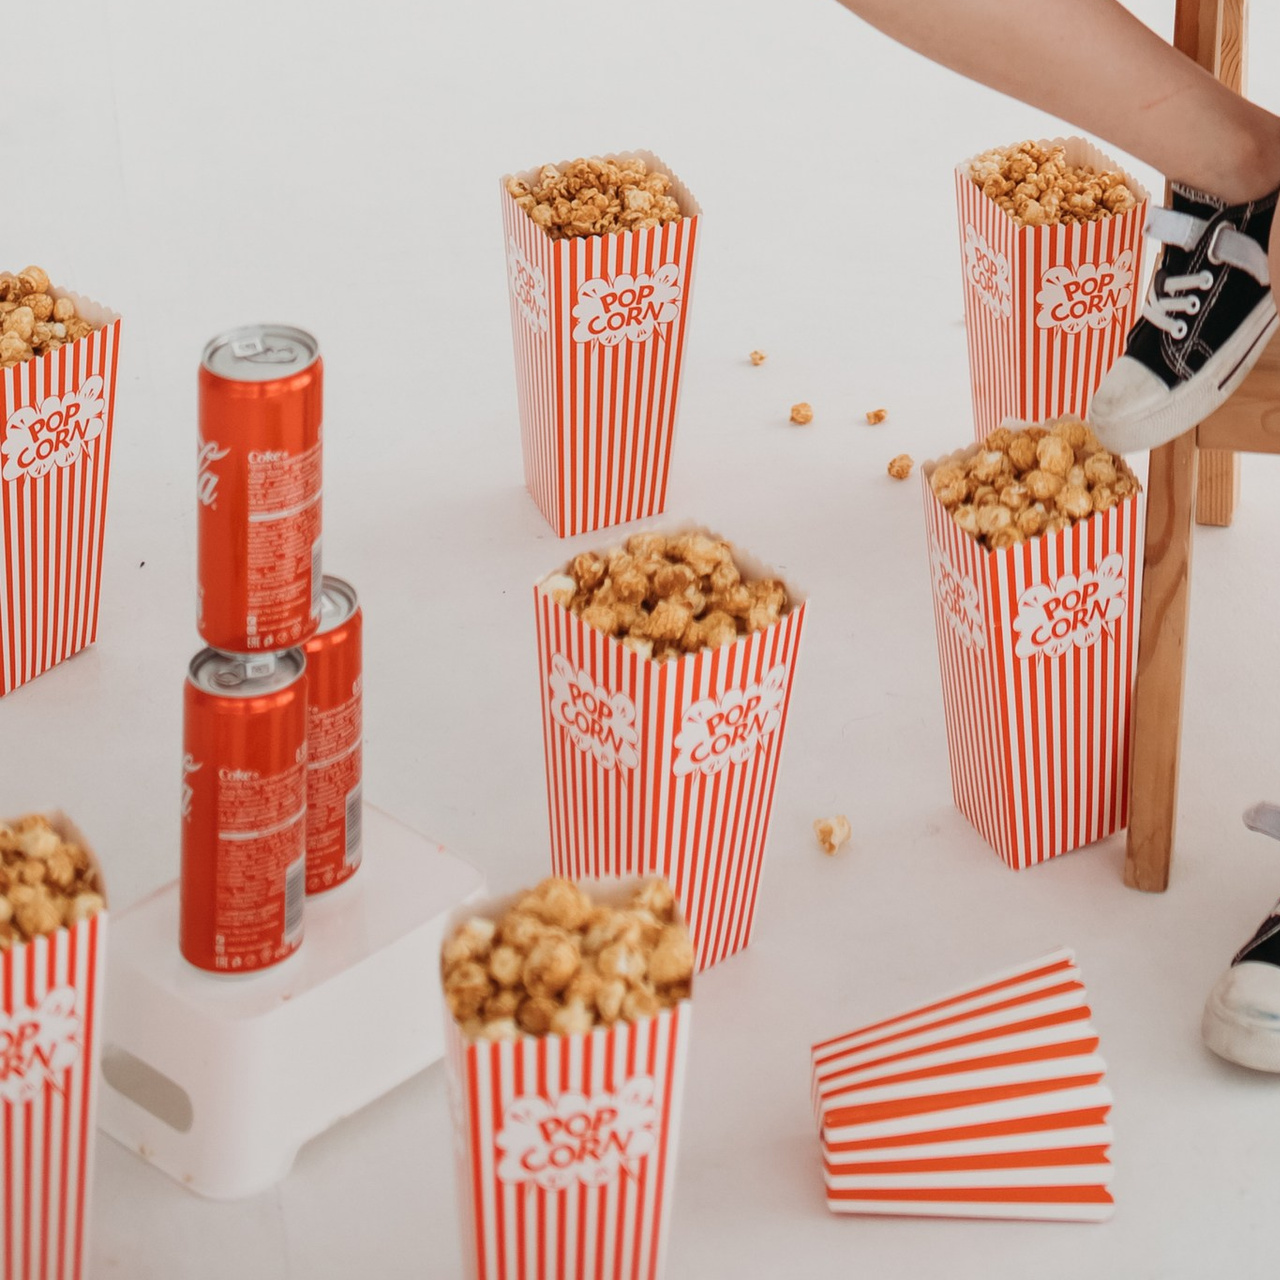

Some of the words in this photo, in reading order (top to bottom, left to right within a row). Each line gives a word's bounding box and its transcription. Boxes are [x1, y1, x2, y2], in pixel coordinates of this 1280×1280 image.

[516, 259, 535, 291] POP
[975, 246, 998, 278] POP
[514, 276, 541, 320] CORN
[599, 284, 655, 314] POP
[972, 263, 1003, 306] CORN
[1063, 272, 1115, 302] POP
[587, 301, 664, 335] CORN
[1050, 288, 1121, 322] CORN
[27, 402, 80, 443] POP
[17, 418, 90, 469] CORN
[940, 561, 965, 601] POP
[1042, 581, 1099, 620] POP
[938, 579, 974, 634] CORN
[1031, 598, 1110, 646] CORN
[568, 682, 613, 721] POP
[706, 695, 761, 737] POP
[560, 702, 624, 754] CORN
[690, 710, 768, 763] CORN
[537, 1107, 619, 1144] POP
[519, 1129, 632, 1173] CORN
